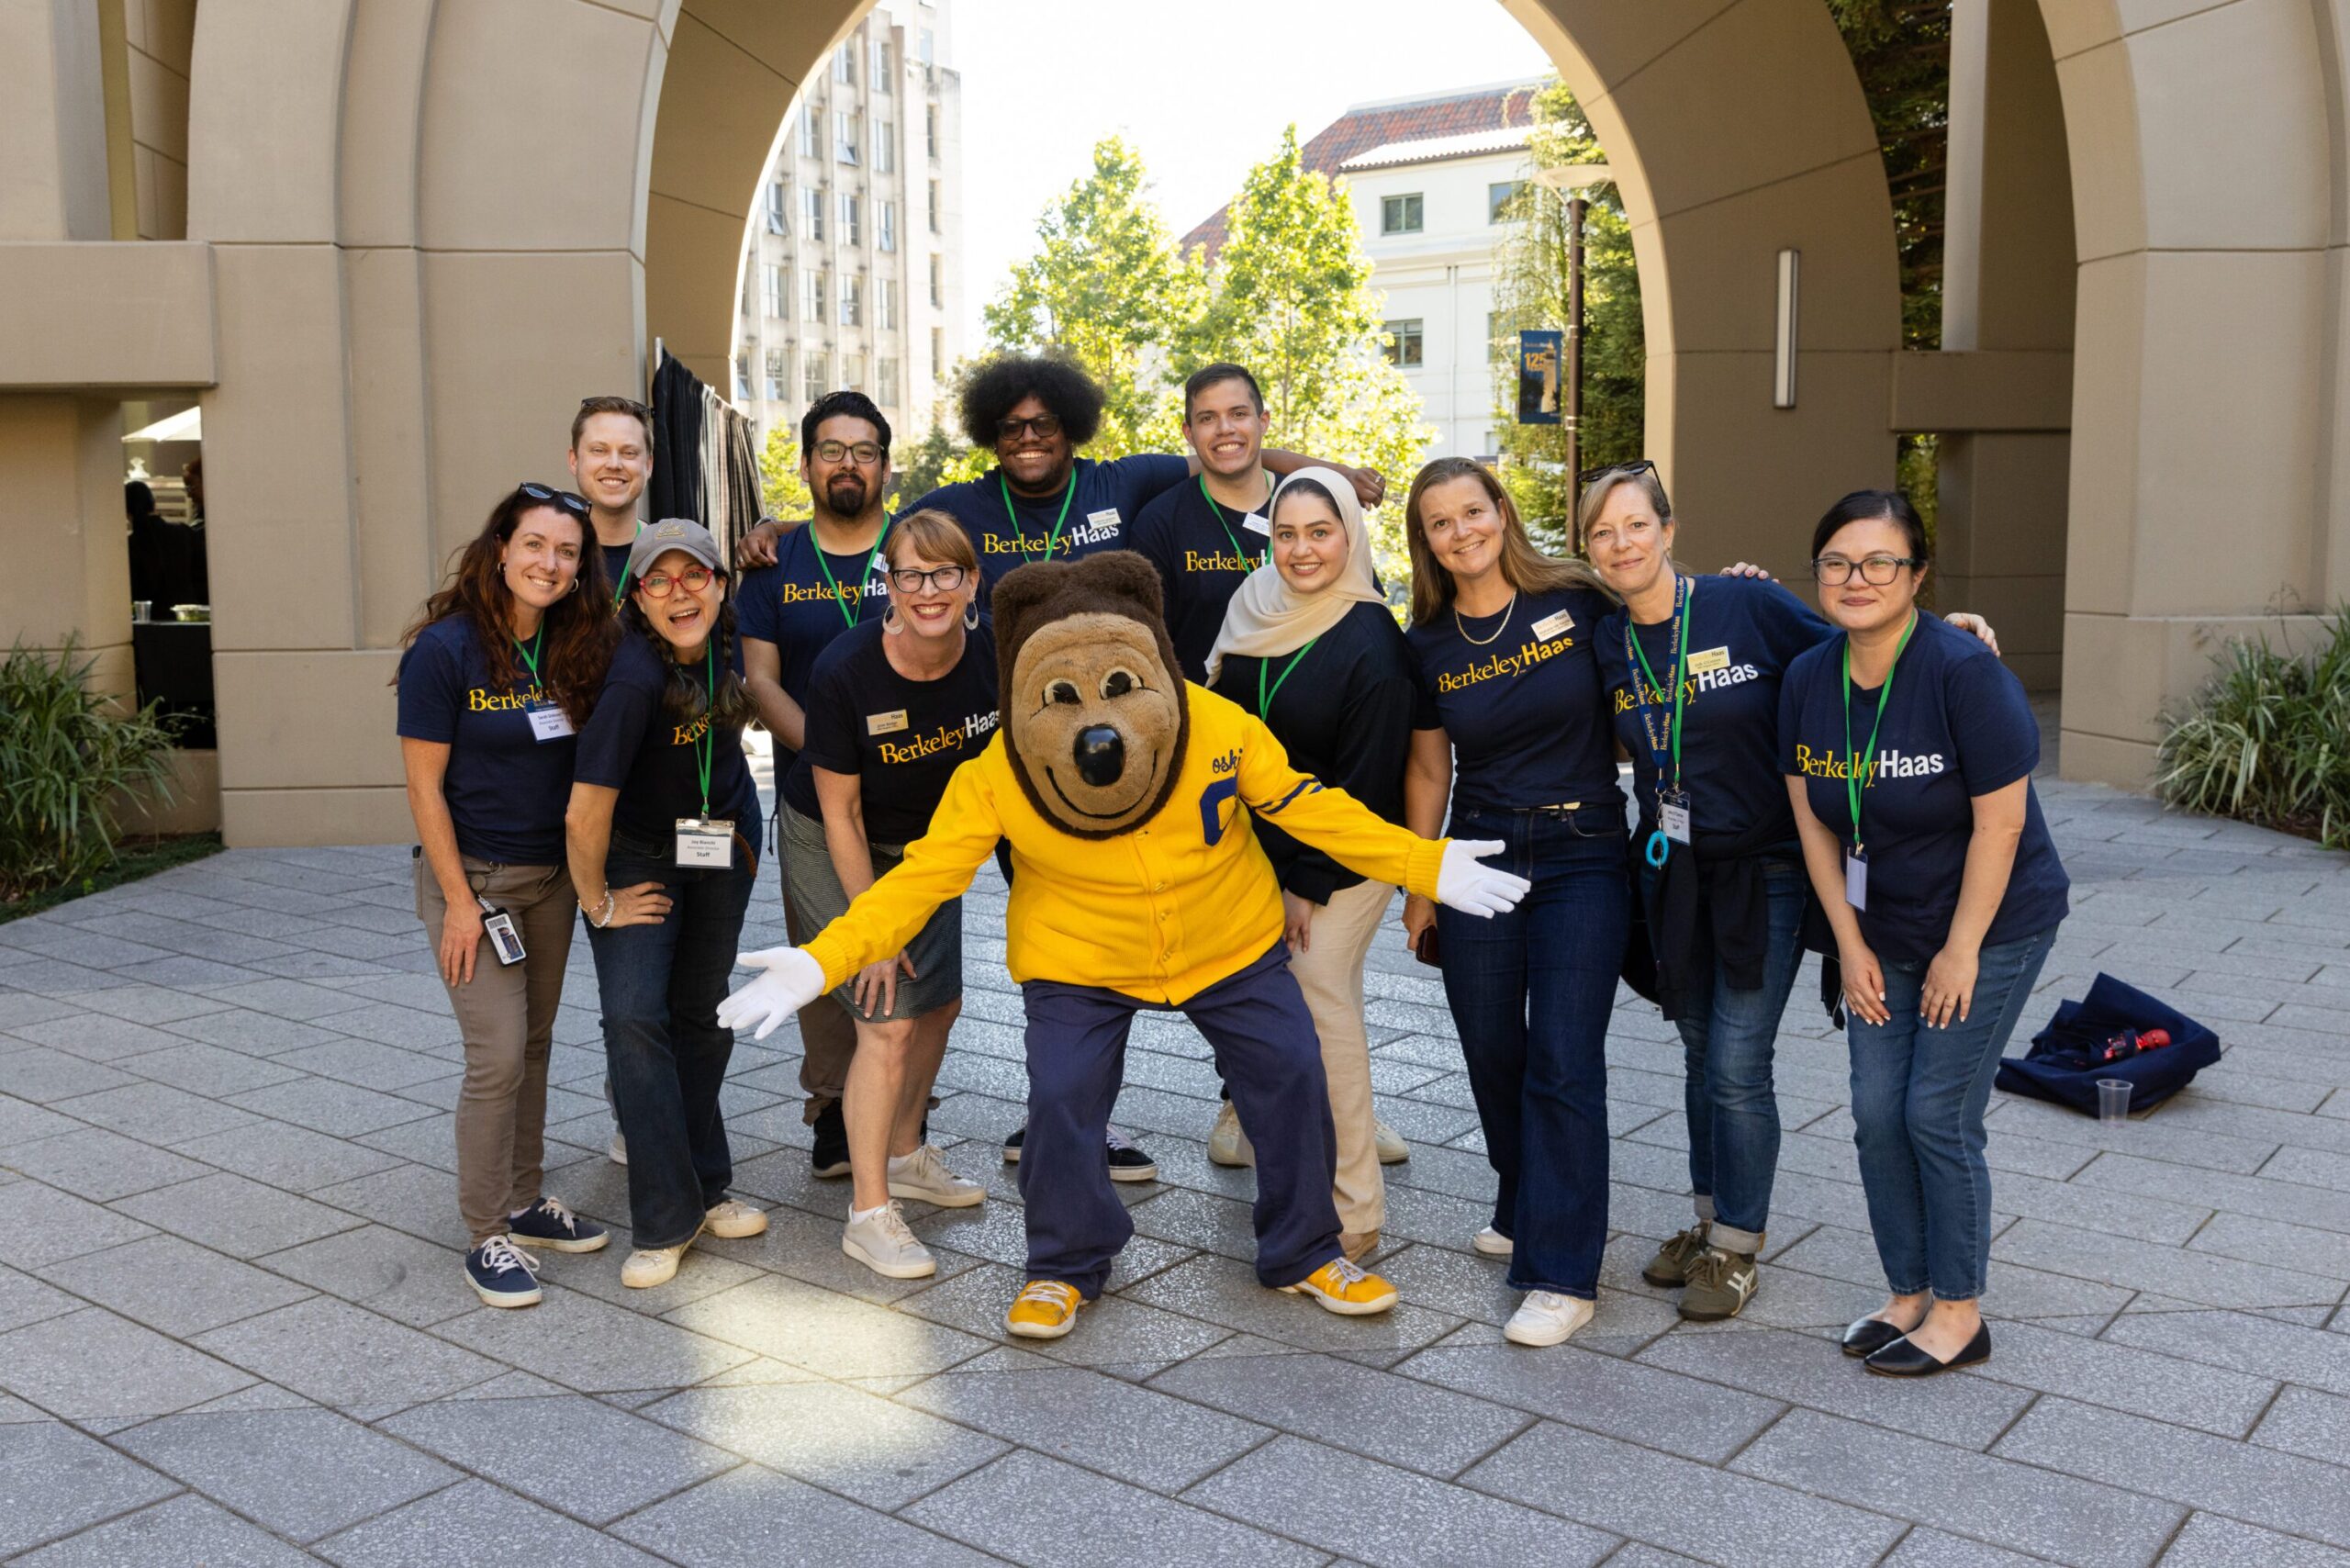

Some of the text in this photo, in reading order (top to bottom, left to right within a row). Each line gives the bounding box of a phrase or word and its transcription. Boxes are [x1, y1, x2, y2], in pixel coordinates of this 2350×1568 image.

[783, 578, 890, 606] BerkeleyHa
[1438, 637, 1574, 693] BerkeleyHaas
[1796, 744, 1945, 789] BerkeleyHaas
